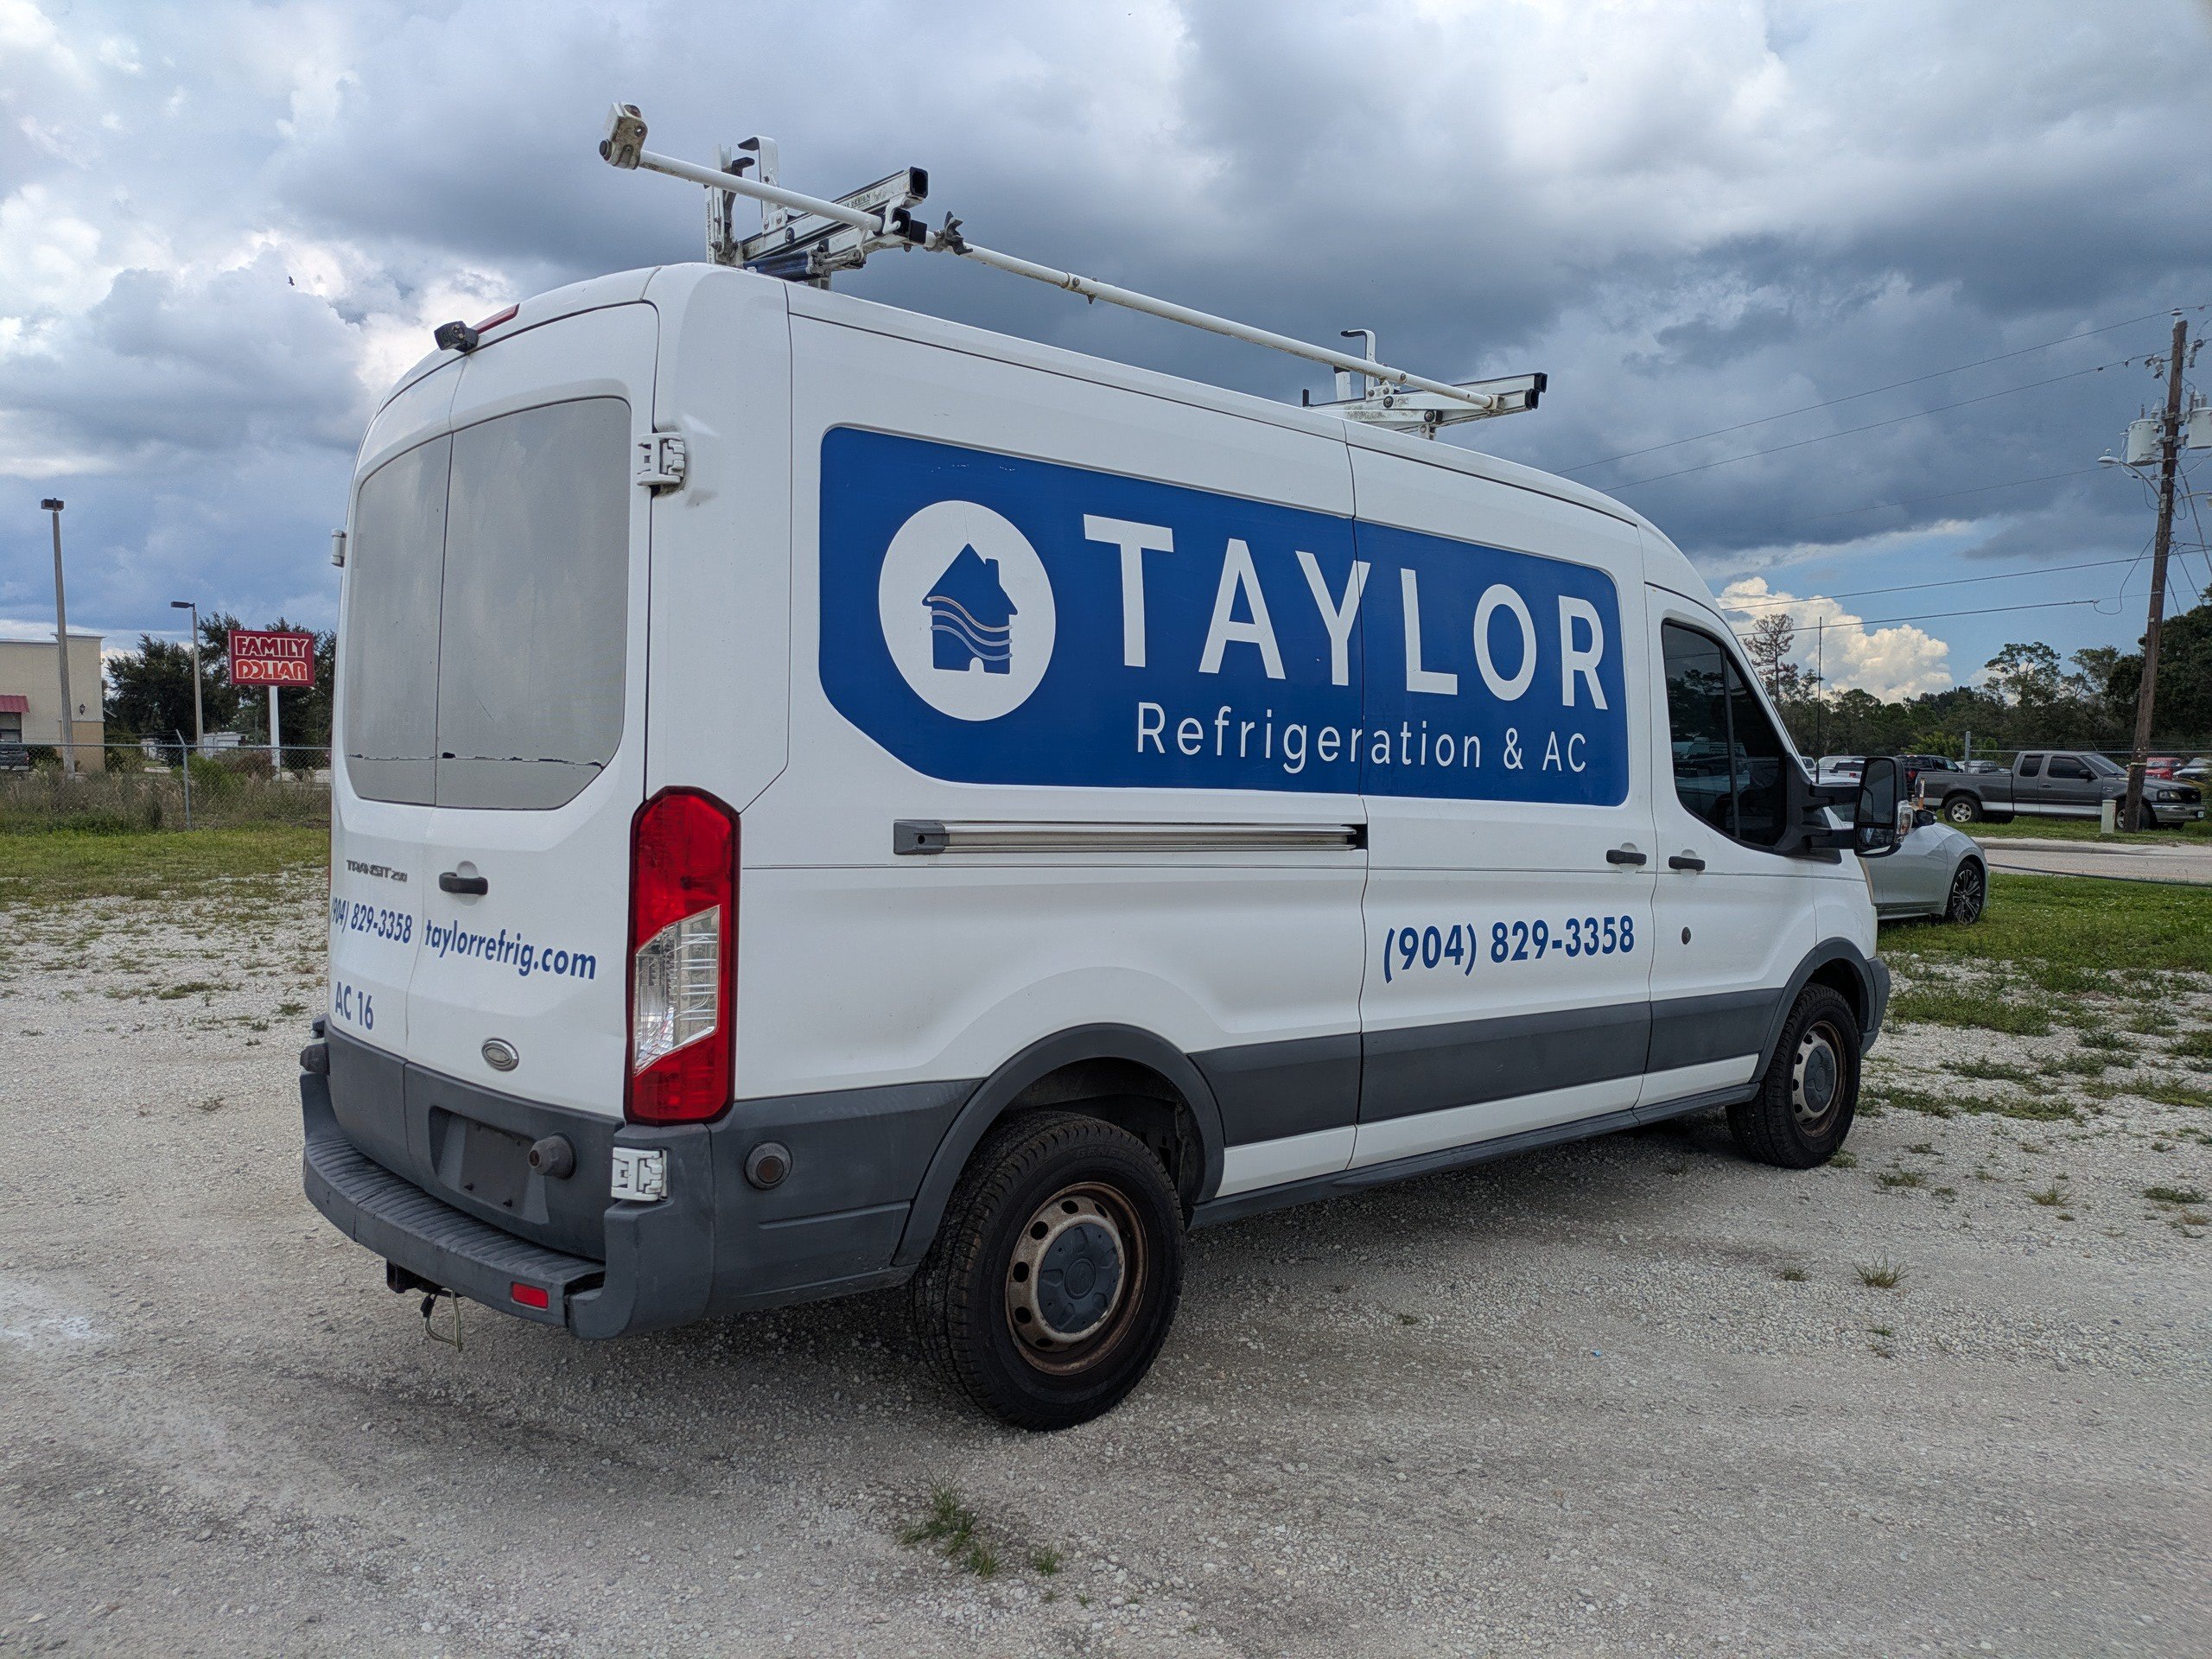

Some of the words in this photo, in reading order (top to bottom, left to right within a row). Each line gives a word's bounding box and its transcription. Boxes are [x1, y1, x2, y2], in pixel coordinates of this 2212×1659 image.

[1083, 513, 1608, 711] TAYLOR
[235, 636, 309, 658] FAMILY
[236, 659, 308, 680] DOLLAR
[1137, 702, 1482, 775] Refrigeration
[1503, 728, 1524, 770] &
[1542, 731, 1588, 773] AC
[351, 902, 412, 944] 829-3358
[424, 919, 596, 980] taylorrefrig.com
[1383, 924, 1477, 983] (904)
[1490, 914, 1635, 963] 829-3358
[335, 982, 352, 1020] AC
[357, 991, 374, 1030] 16
